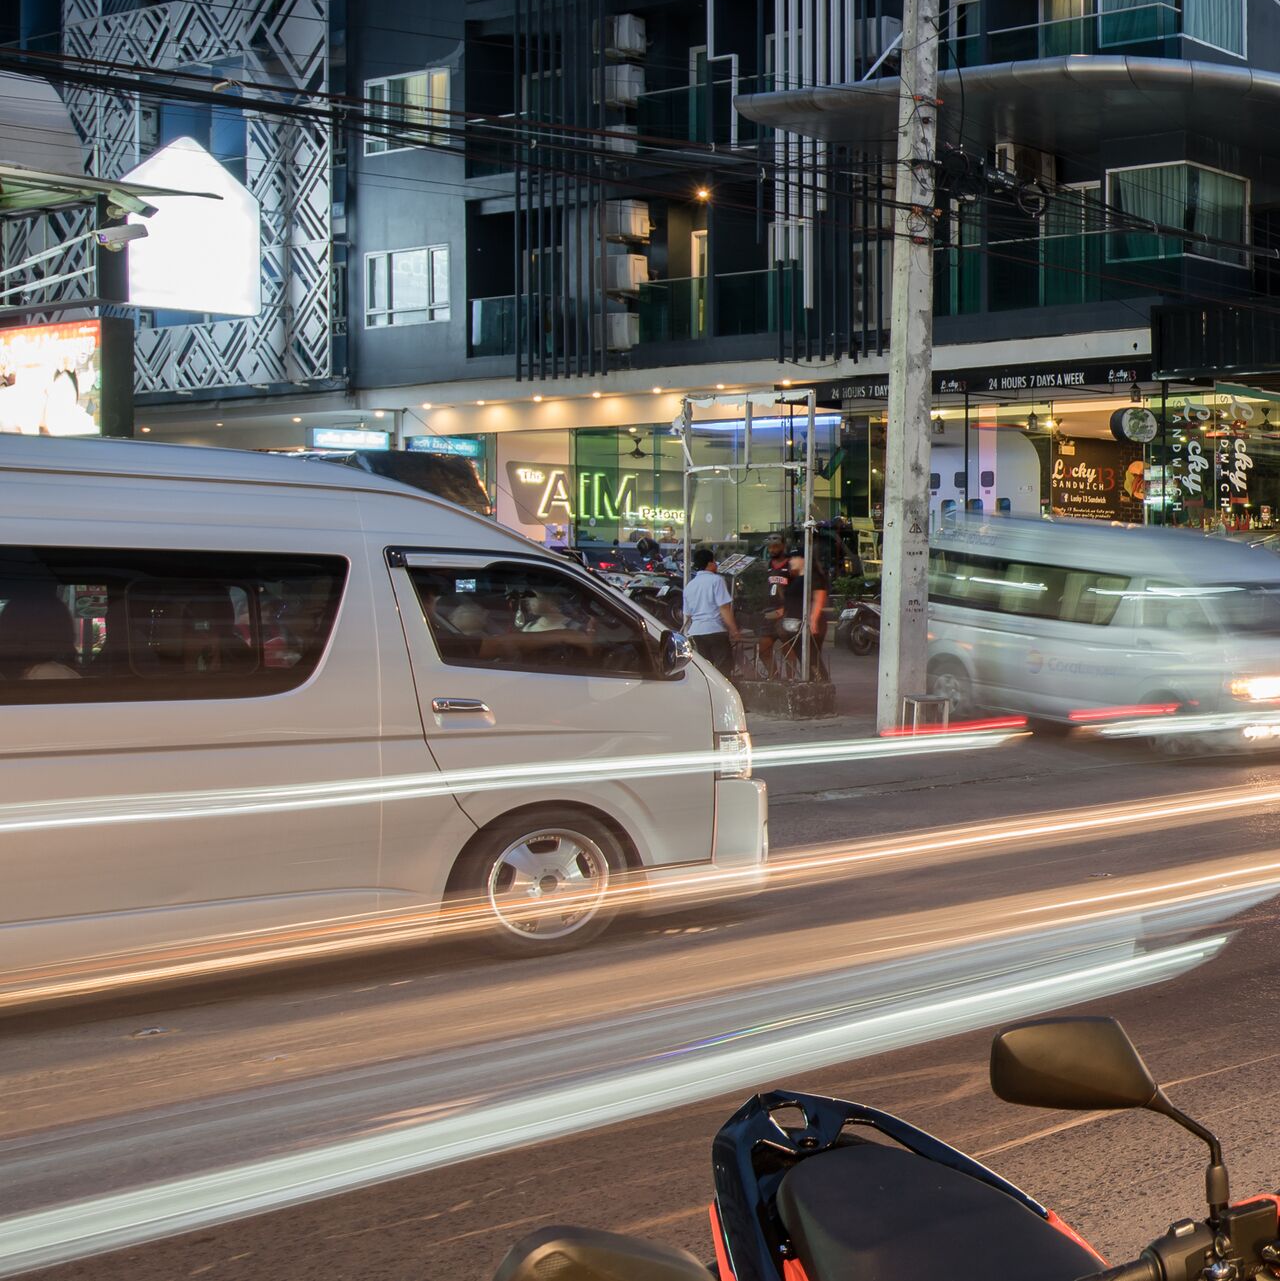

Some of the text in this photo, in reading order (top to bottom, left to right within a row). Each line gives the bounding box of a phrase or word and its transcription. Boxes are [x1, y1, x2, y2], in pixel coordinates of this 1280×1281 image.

[988, 372, 1085, 391] 24 HOURS 7 DAYS A WEEK
[831, 384, 889, 400] 24 HOURS 7 DAY
[1172, 399, 1183, 512] SANDWICH
[1052, 458, 1097, 483] Lucky
[1052, 480, 1105, 491] SANDWICH
[1070, 495, 1082, 504] Lucky
[1087, 495, 1107, 504] Sandwich
